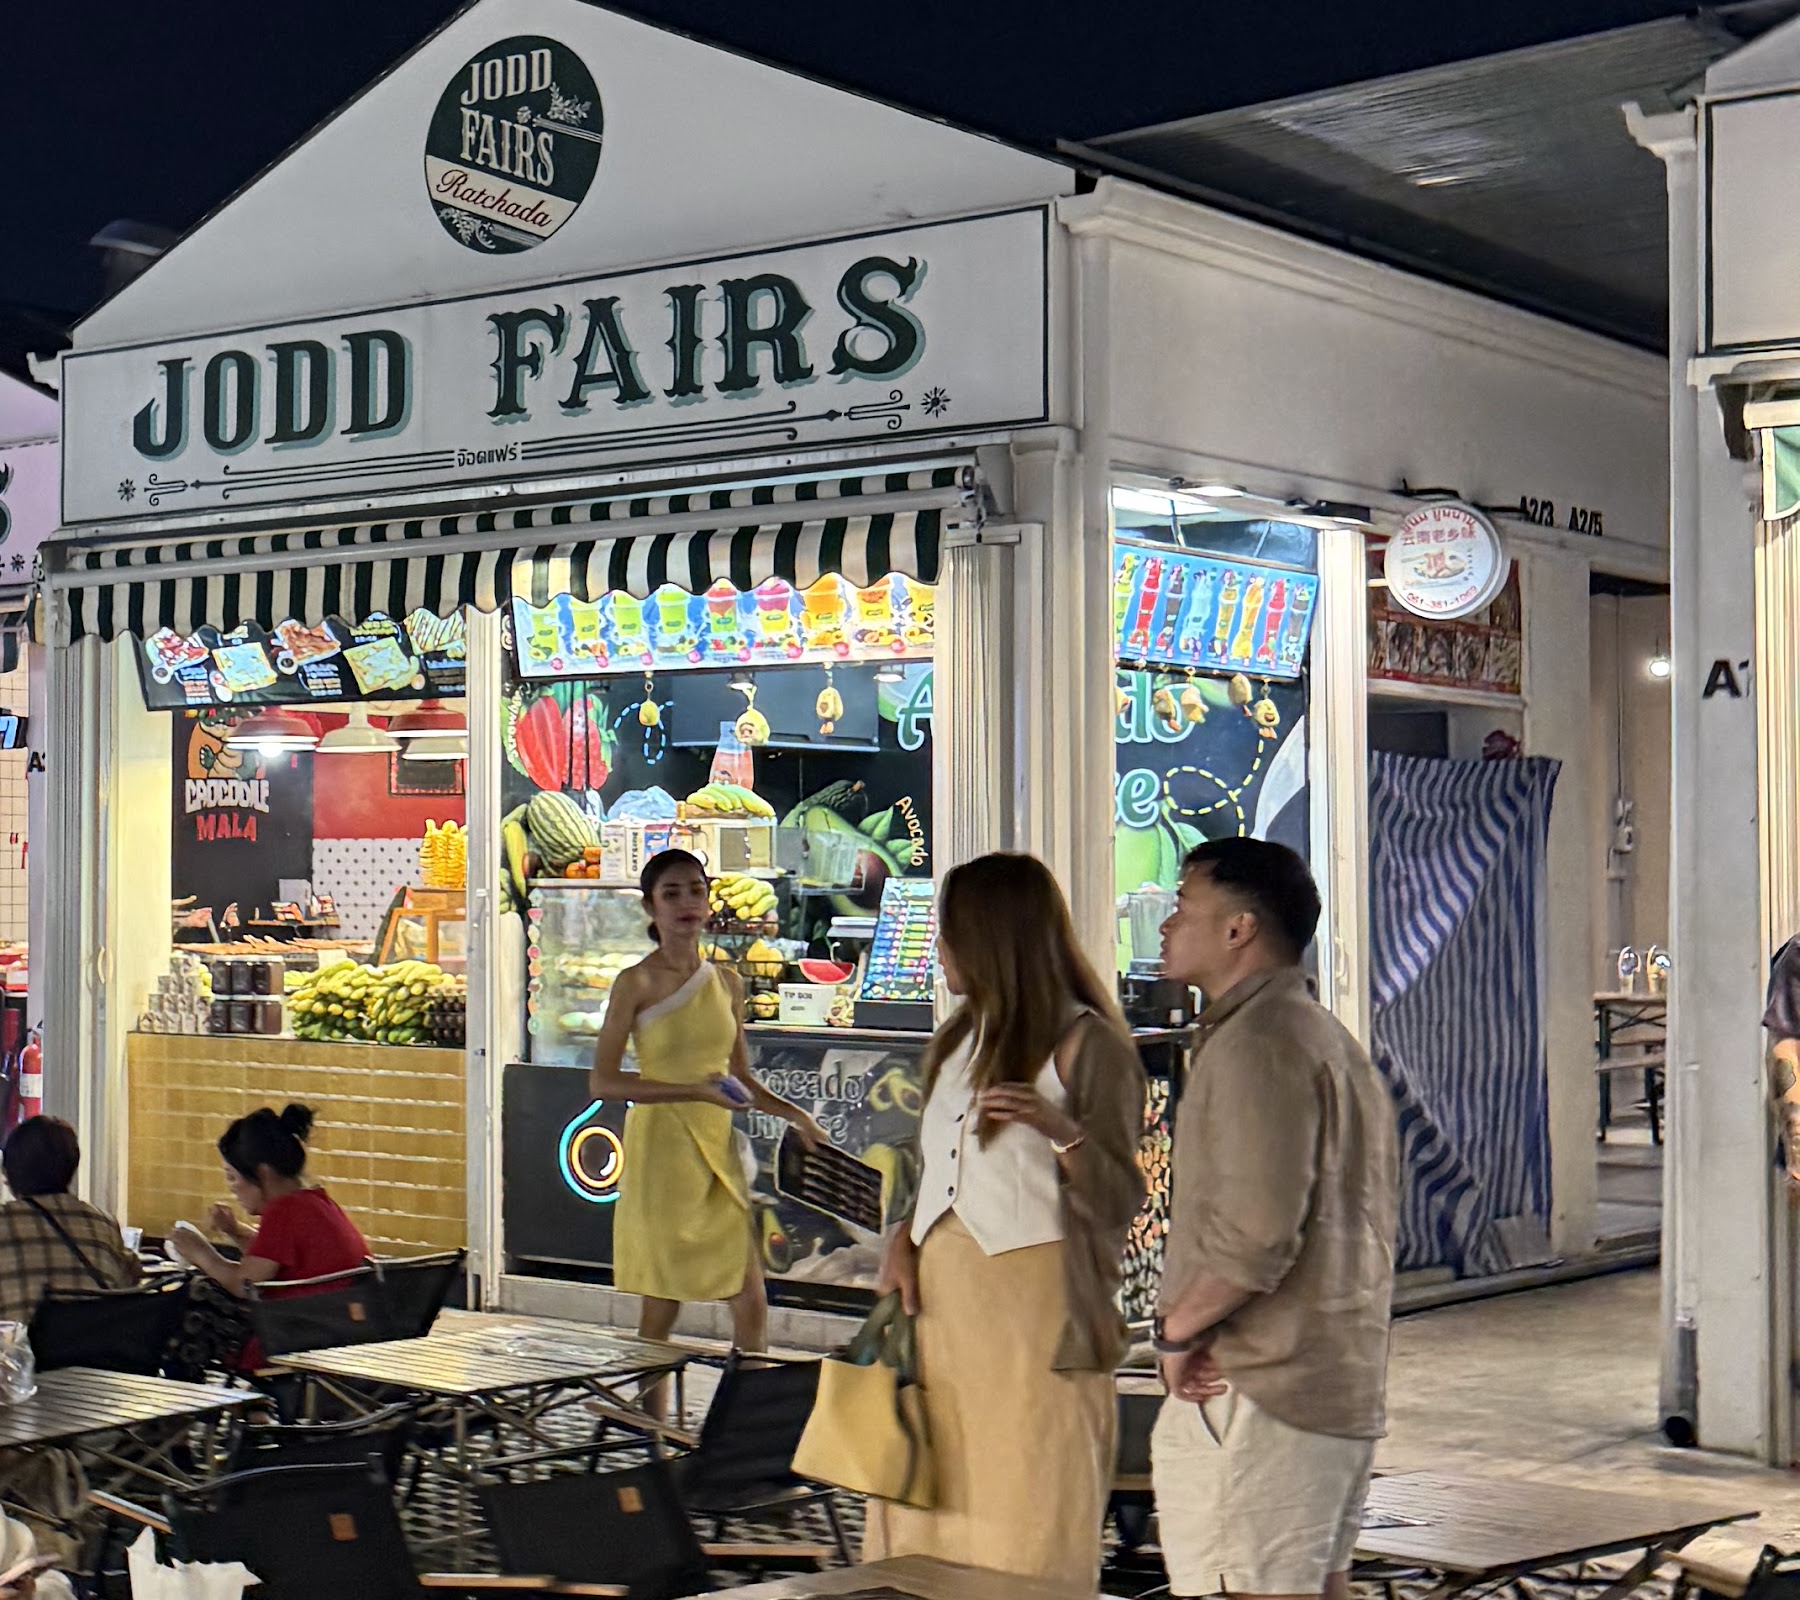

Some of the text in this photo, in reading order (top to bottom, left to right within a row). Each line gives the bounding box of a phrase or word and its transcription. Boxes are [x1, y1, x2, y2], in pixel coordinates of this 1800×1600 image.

[460, 48, 552, 106] JODD
[460, 106, 555, 188] FAIRS
[436, 168, 552, 228] Ratchada
[133, 256, 928, 461] JODD FAIRS
[185, 778, 269, 814] CROCODILE
[196, 812, 257, 842] MALA
[896, 795, 930, 867] Avocado
